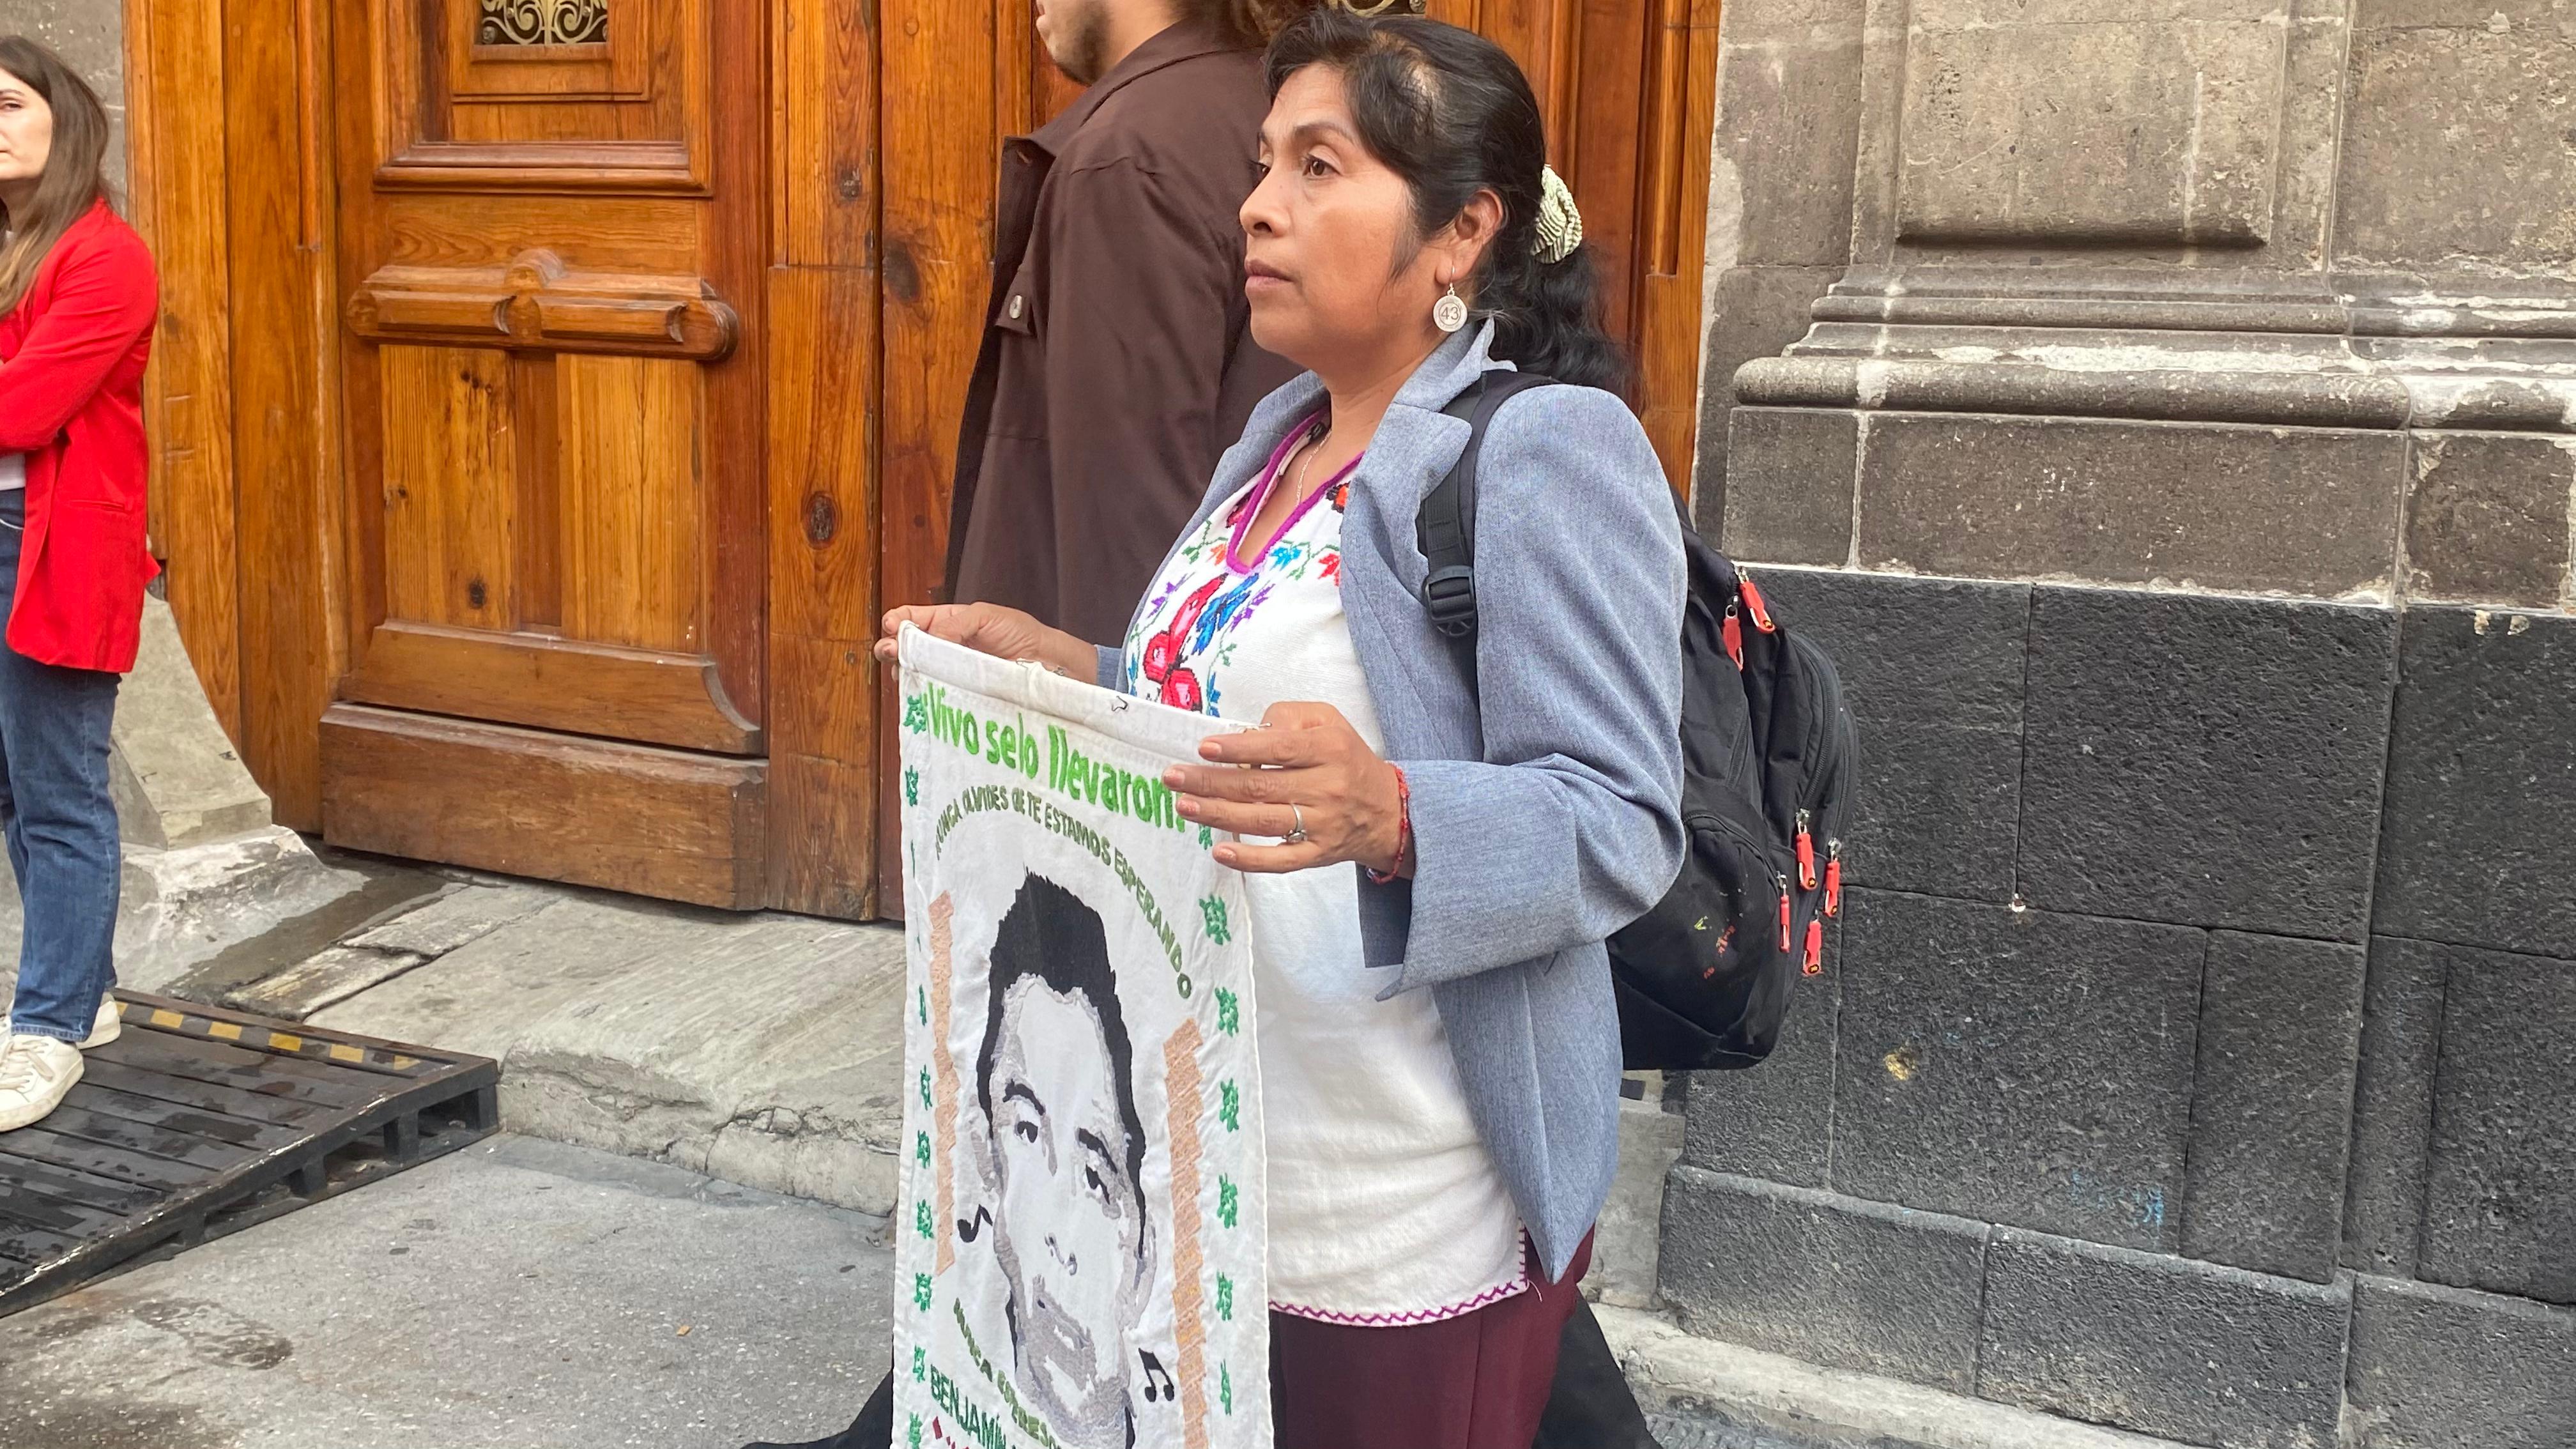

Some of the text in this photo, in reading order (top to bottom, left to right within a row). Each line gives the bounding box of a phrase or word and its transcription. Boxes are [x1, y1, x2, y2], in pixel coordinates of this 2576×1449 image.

[1441, 307, 1459, 320] 43
[935, 798, 963, 861] NUNCA
[1027, 791, 1041, 824] TE
[1045, 802, 1111, 866] ESTAMOS
[1114, 847, 1192, 999] ESPERANDO
